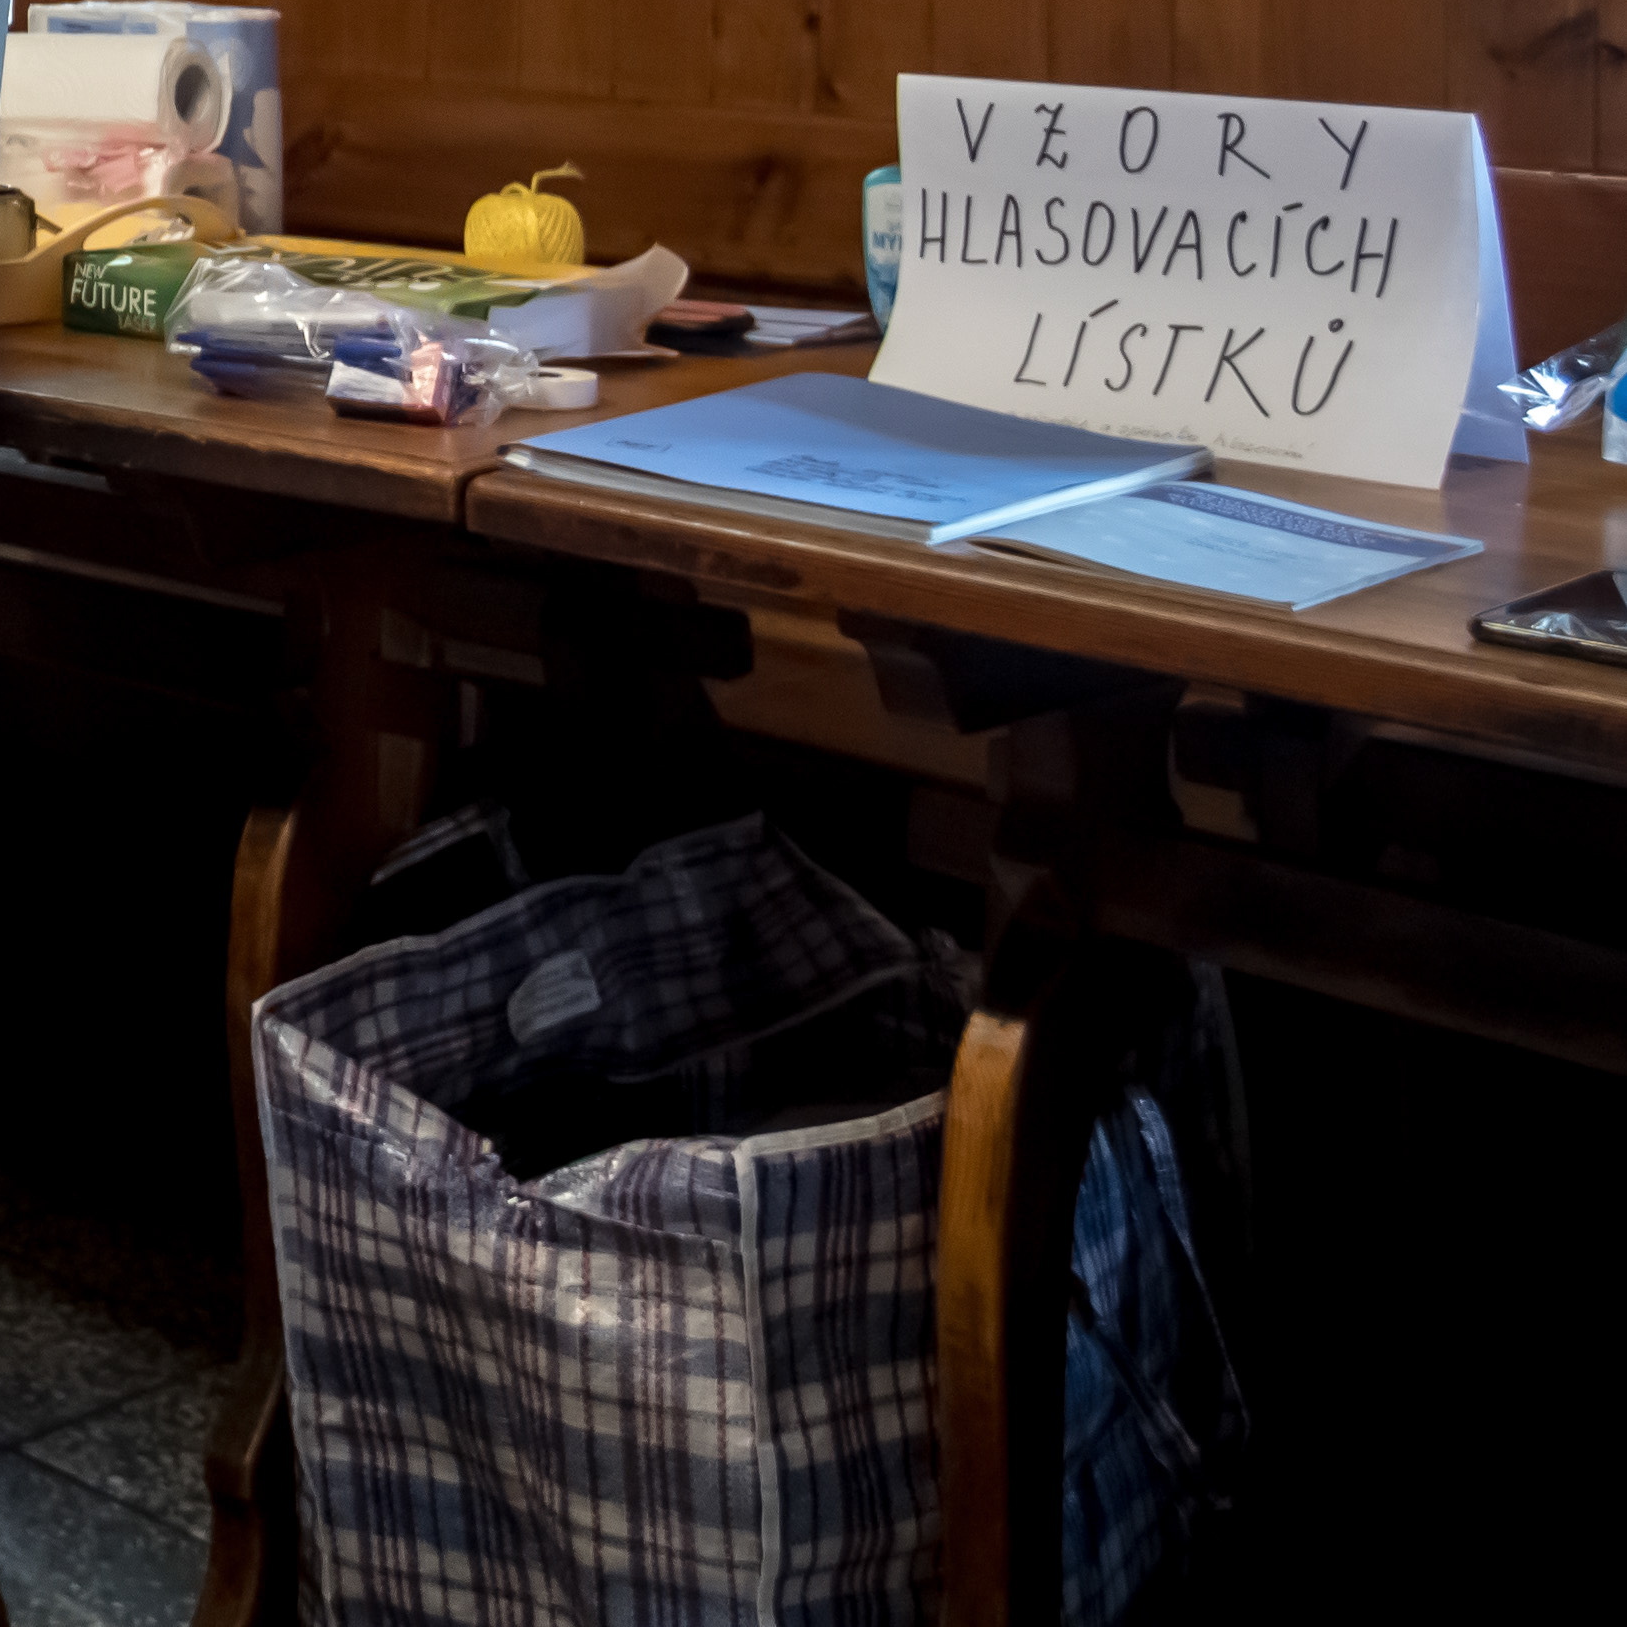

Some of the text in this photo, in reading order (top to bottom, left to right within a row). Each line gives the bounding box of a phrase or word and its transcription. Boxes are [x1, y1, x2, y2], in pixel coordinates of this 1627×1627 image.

[956, 97, 1368, 191] VZORY
[74, 261, 109, 280] NEW
[918, 187, 1398, 298] HLASOVACÍCH
[70, 277, 157, 317] FUTURE
[1013, 298, 1354, 418] LÍSTKŮ
